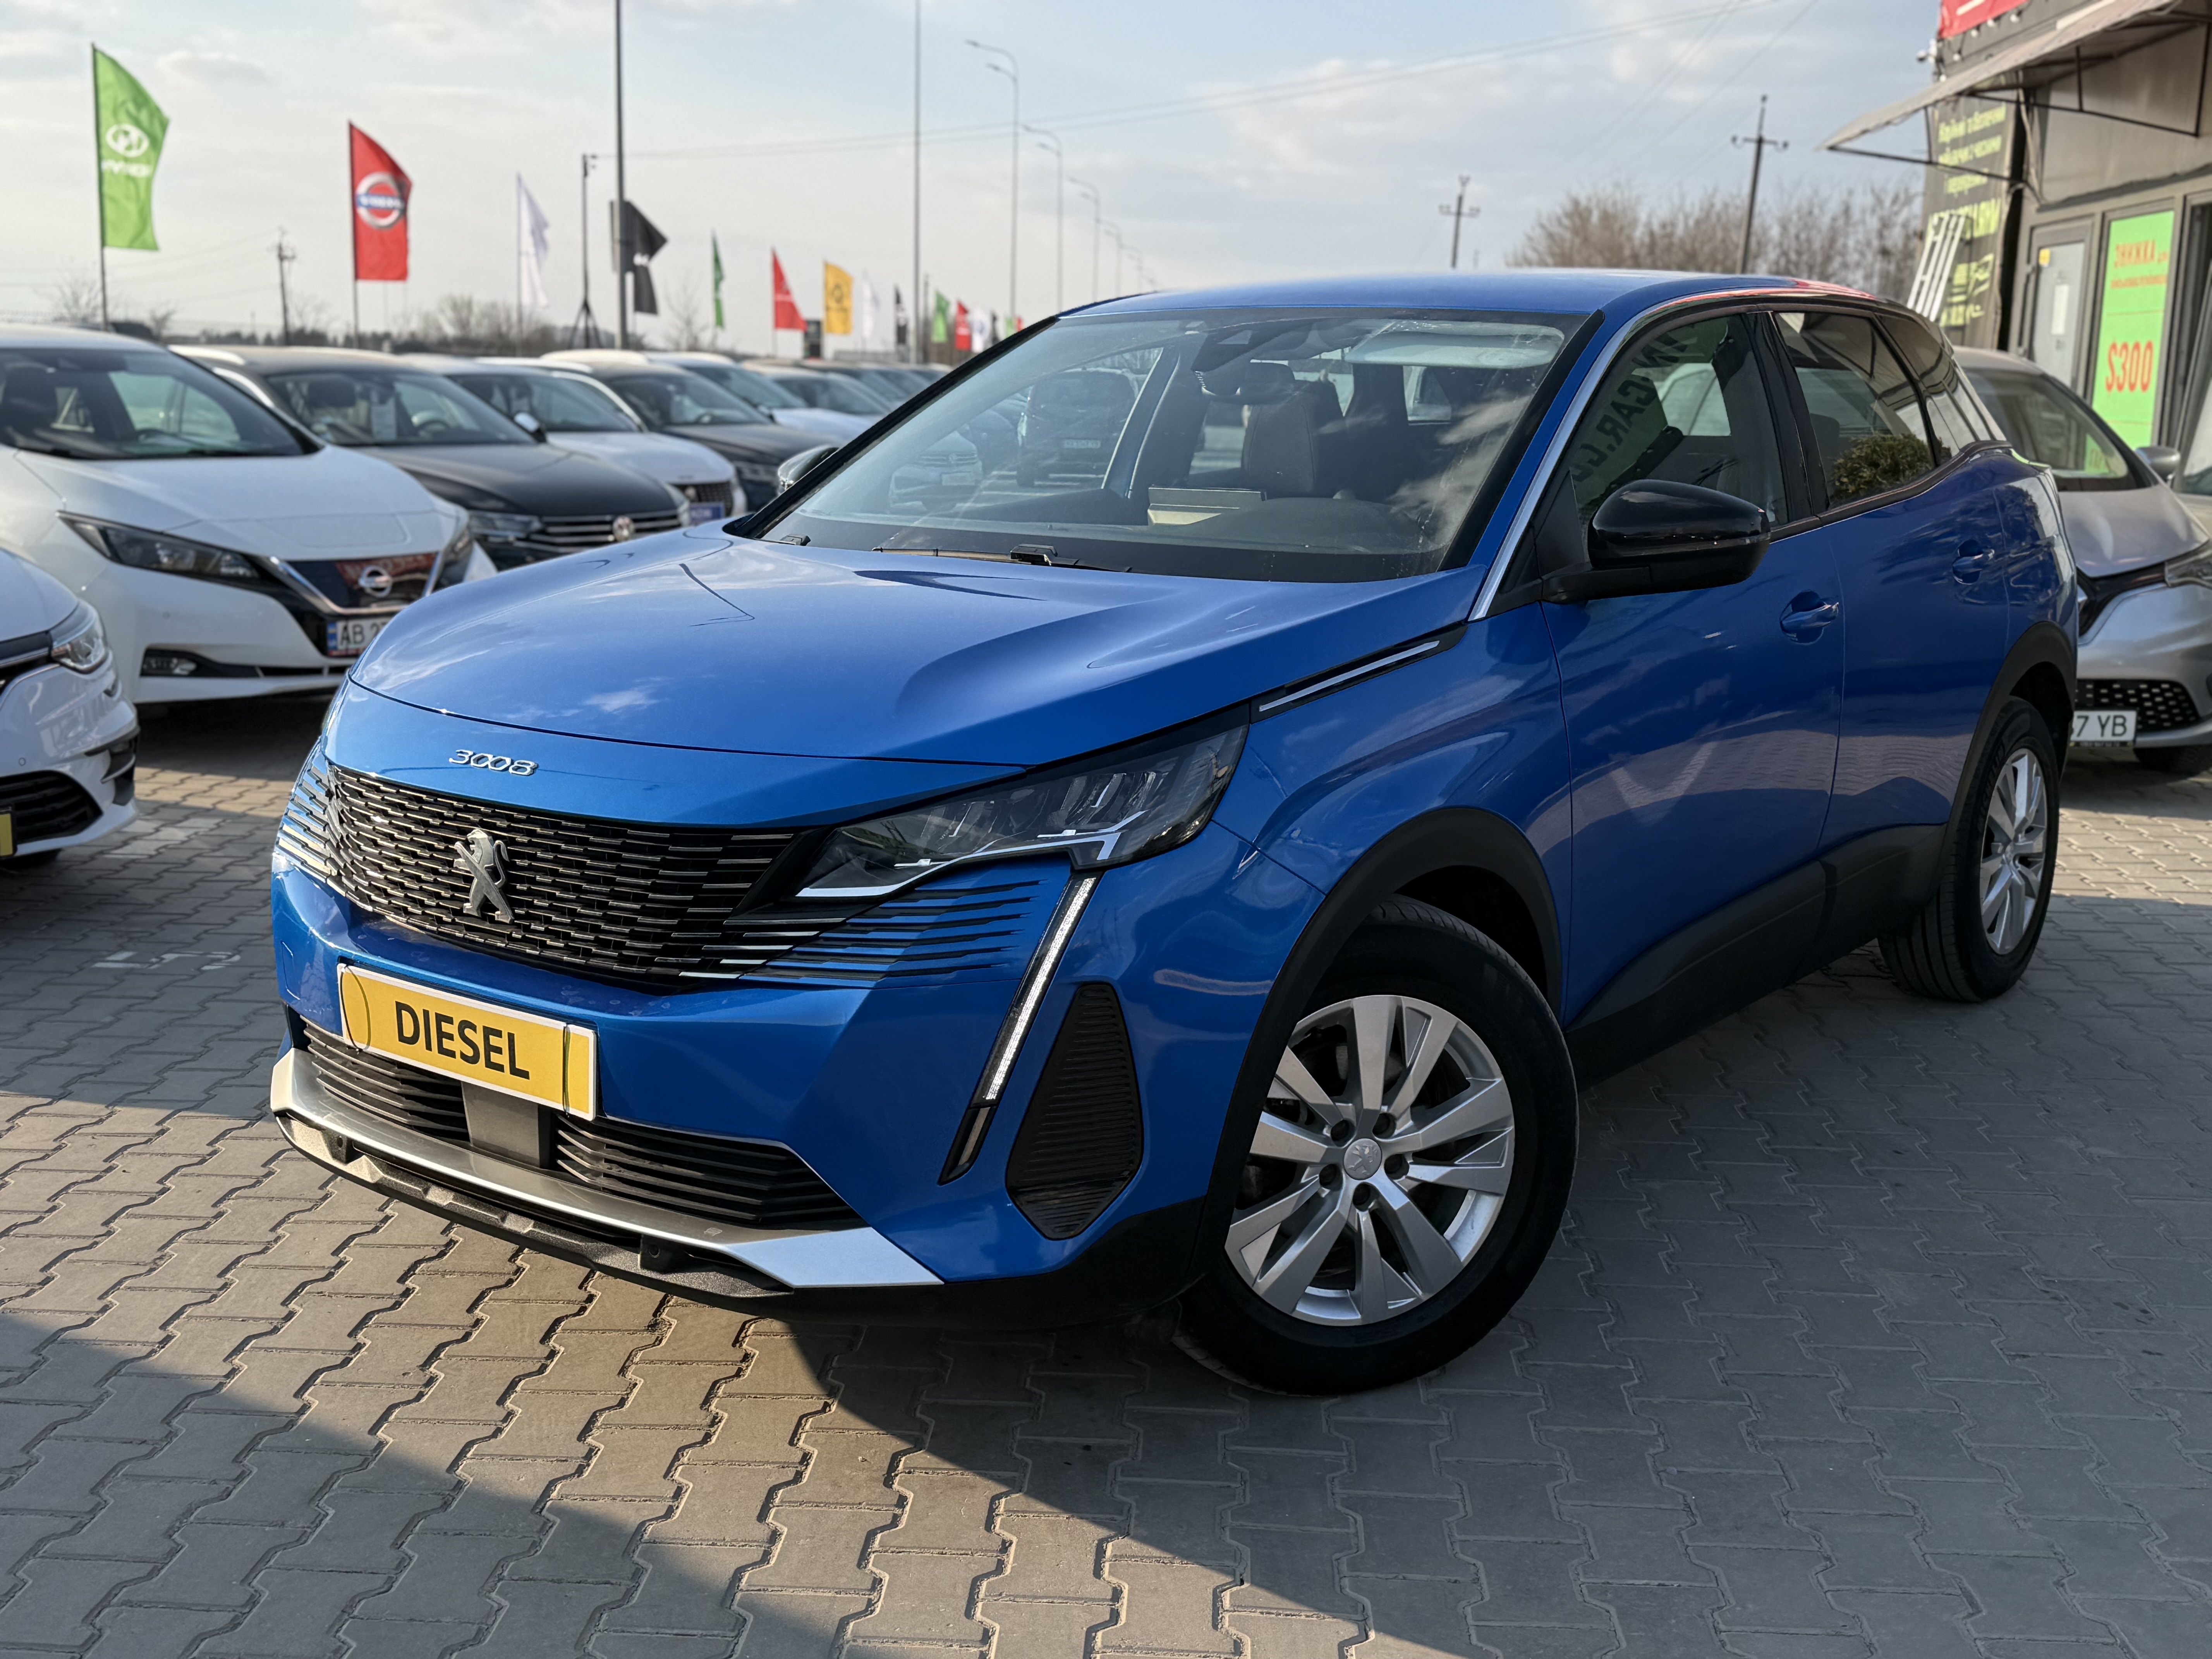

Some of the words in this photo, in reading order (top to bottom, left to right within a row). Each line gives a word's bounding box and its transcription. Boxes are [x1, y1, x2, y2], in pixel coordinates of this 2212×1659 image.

[340, 623, 365, 646] AB
[2072, 715, 2089, 737] 7
[2097, 715, 2127, 737] YB
[448, 749, 538, 776] 3008
[395, 1001, 530, 1080] DIESEL
